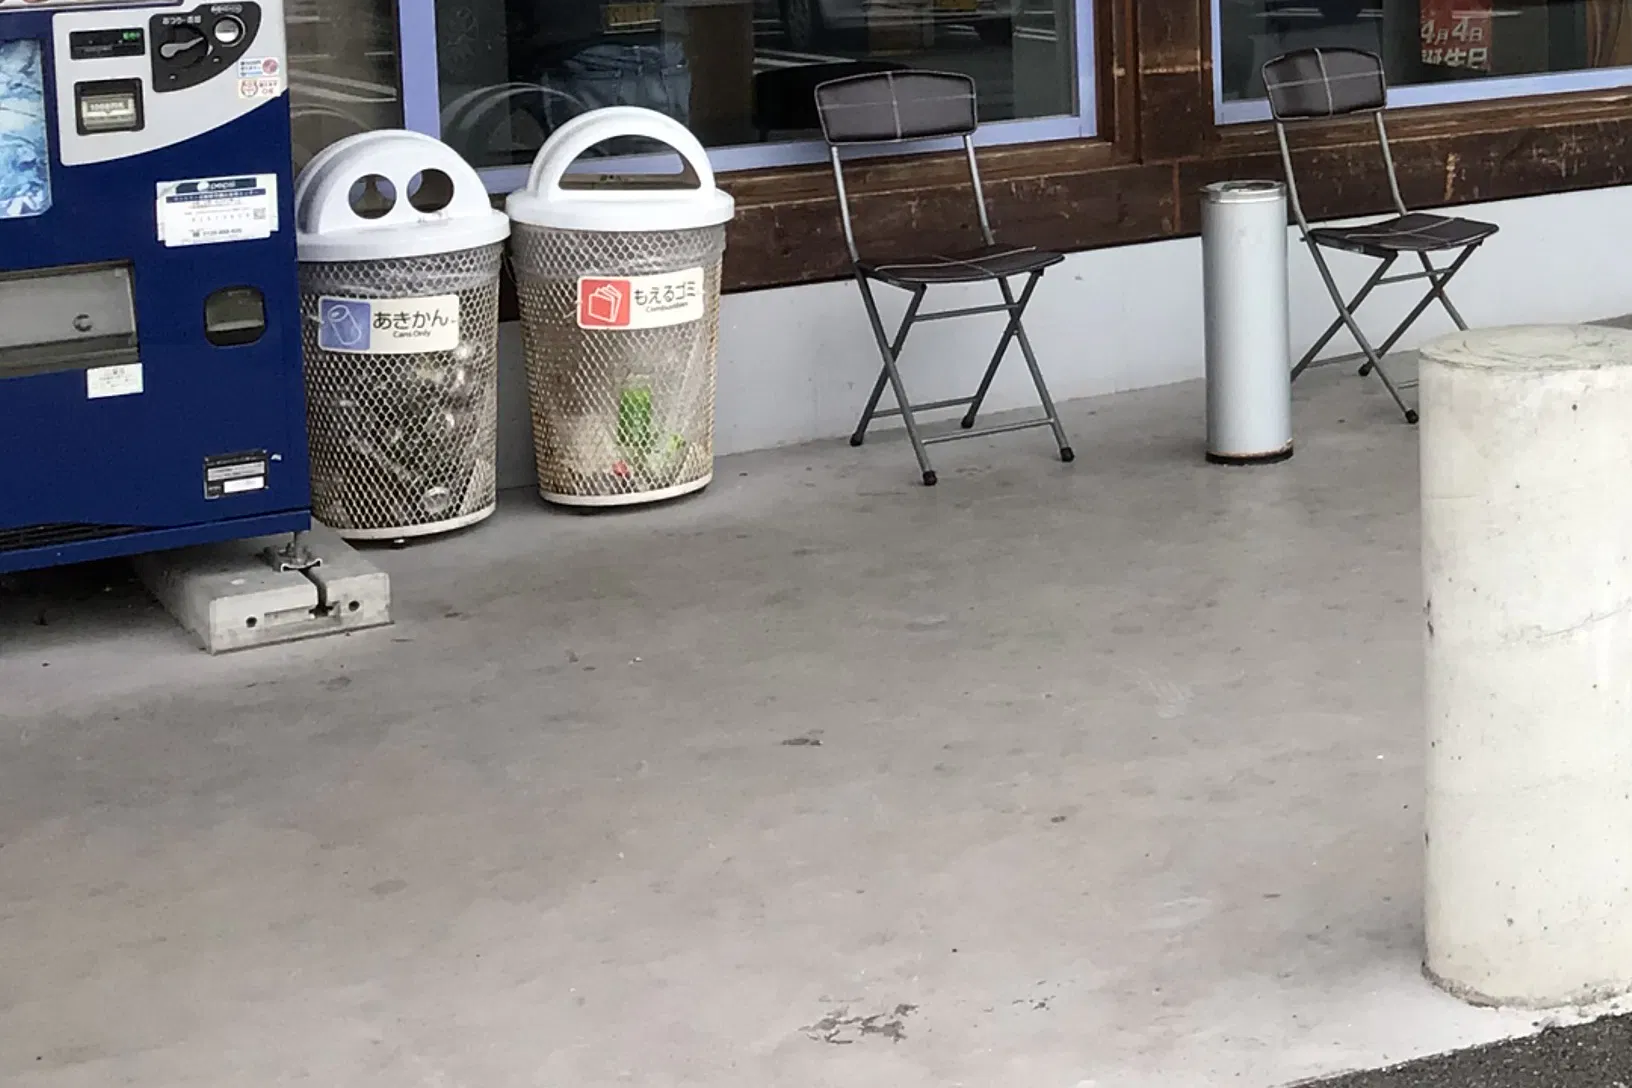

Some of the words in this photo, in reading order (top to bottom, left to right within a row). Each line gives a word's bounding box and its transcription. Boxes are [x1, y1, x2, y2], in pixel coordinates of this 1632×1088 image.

[1421, 16, 1483, 45] 4月4日
[634, 281, 696, 305] もえるゴミ
[372, 309, 449, 330] あきかん
